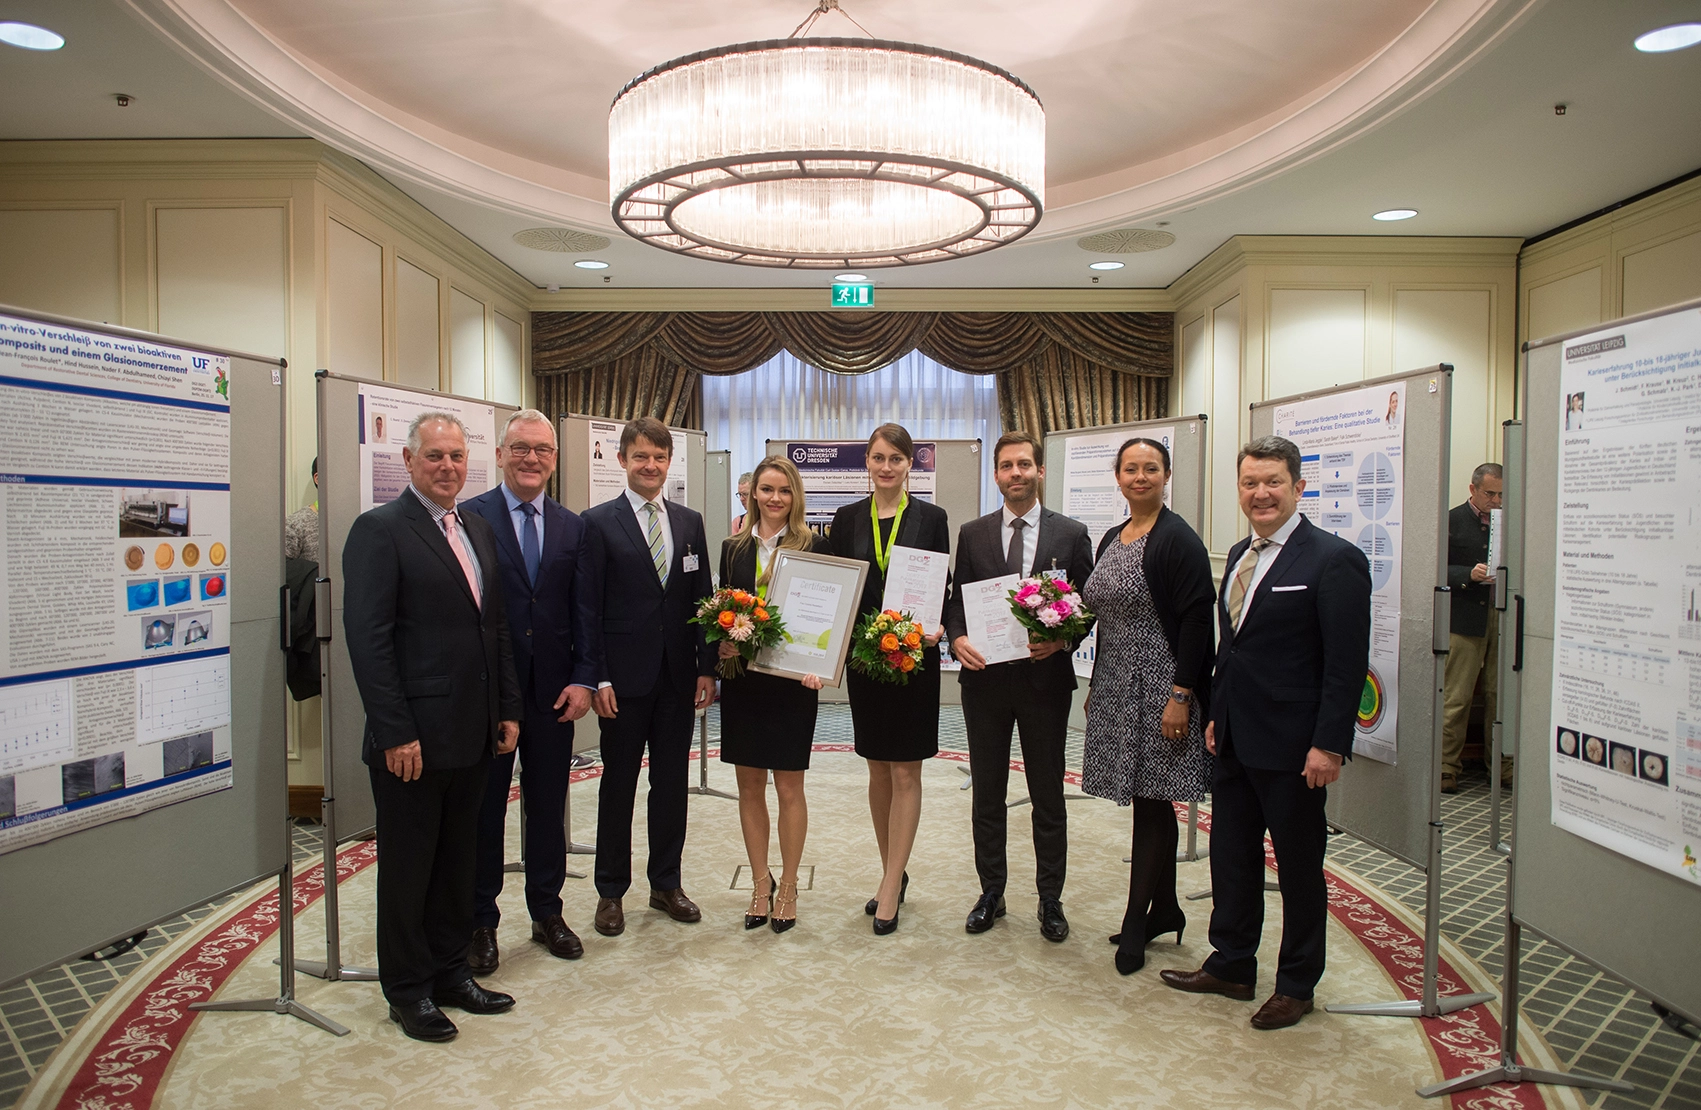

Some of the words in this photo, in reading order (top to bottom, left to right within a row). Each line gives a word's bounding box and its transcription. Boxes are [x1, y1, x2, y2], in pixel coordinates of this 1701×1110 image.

[0, 338, 46, 352] omposits
[50, 346, 68, 355] und
[72, 348, 101, 360] einem
[104, 352, 188, 374] Glasionomerzement
[94, 340, 111, 348] von
[114, 343, 135, 352] zwei
[137, 345, 182, 361] bioaktiven
[1567, 343, 1601, 358] UNIVERSITÄT
[1602, 338, 1624, 350] LEIPZIG
[0, 350, 38, 361] ean-François
[78, 363, 100, 371] Hussein,
[192, 357, 210, 369] UF
[1588, 362, 1634, 376] Karieserfahrung
[1656, 351, 1690, 364] 18-jähriger
[1605, 374, 1620, 382] unter
[1621, 364, 1676, 380] Berücksichtigung
[1289, 428, 1309, 436] Behandlung
[1344, 420, 1365, 429] qualitative
[1295, 419, 1311, 427] Barrieren
[1320, 415, 1338, 423] fördernde
[1339, 412, 1357, 420] Faktoren
[800, 581, 836, 594] Certificate
[5, 806, 68, 827] Schlußfolgerungen
